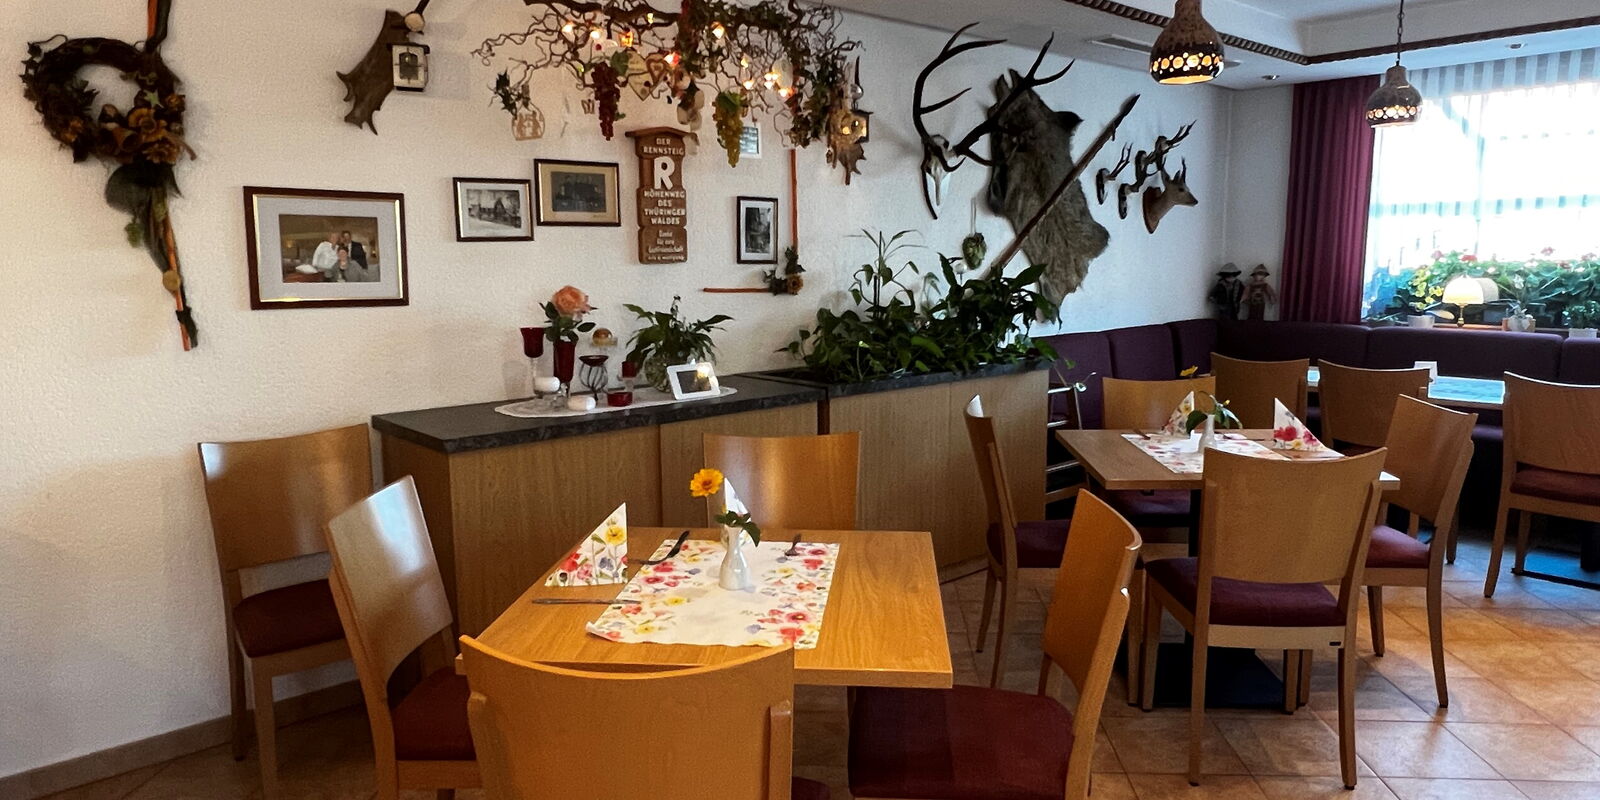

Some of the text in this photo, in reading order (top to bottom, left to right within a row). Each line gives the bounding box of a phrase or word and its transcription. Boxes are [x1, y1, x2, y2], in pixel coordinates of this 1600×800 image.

[643, 146, 684, 155] RENNSTEIG
[654, 156, 675, 190] R
[644, 189, 686, 198] HÖHENWEG
[657, 199, 672, 207] DES
[644, 206, 686, 216] THÜRINGER
